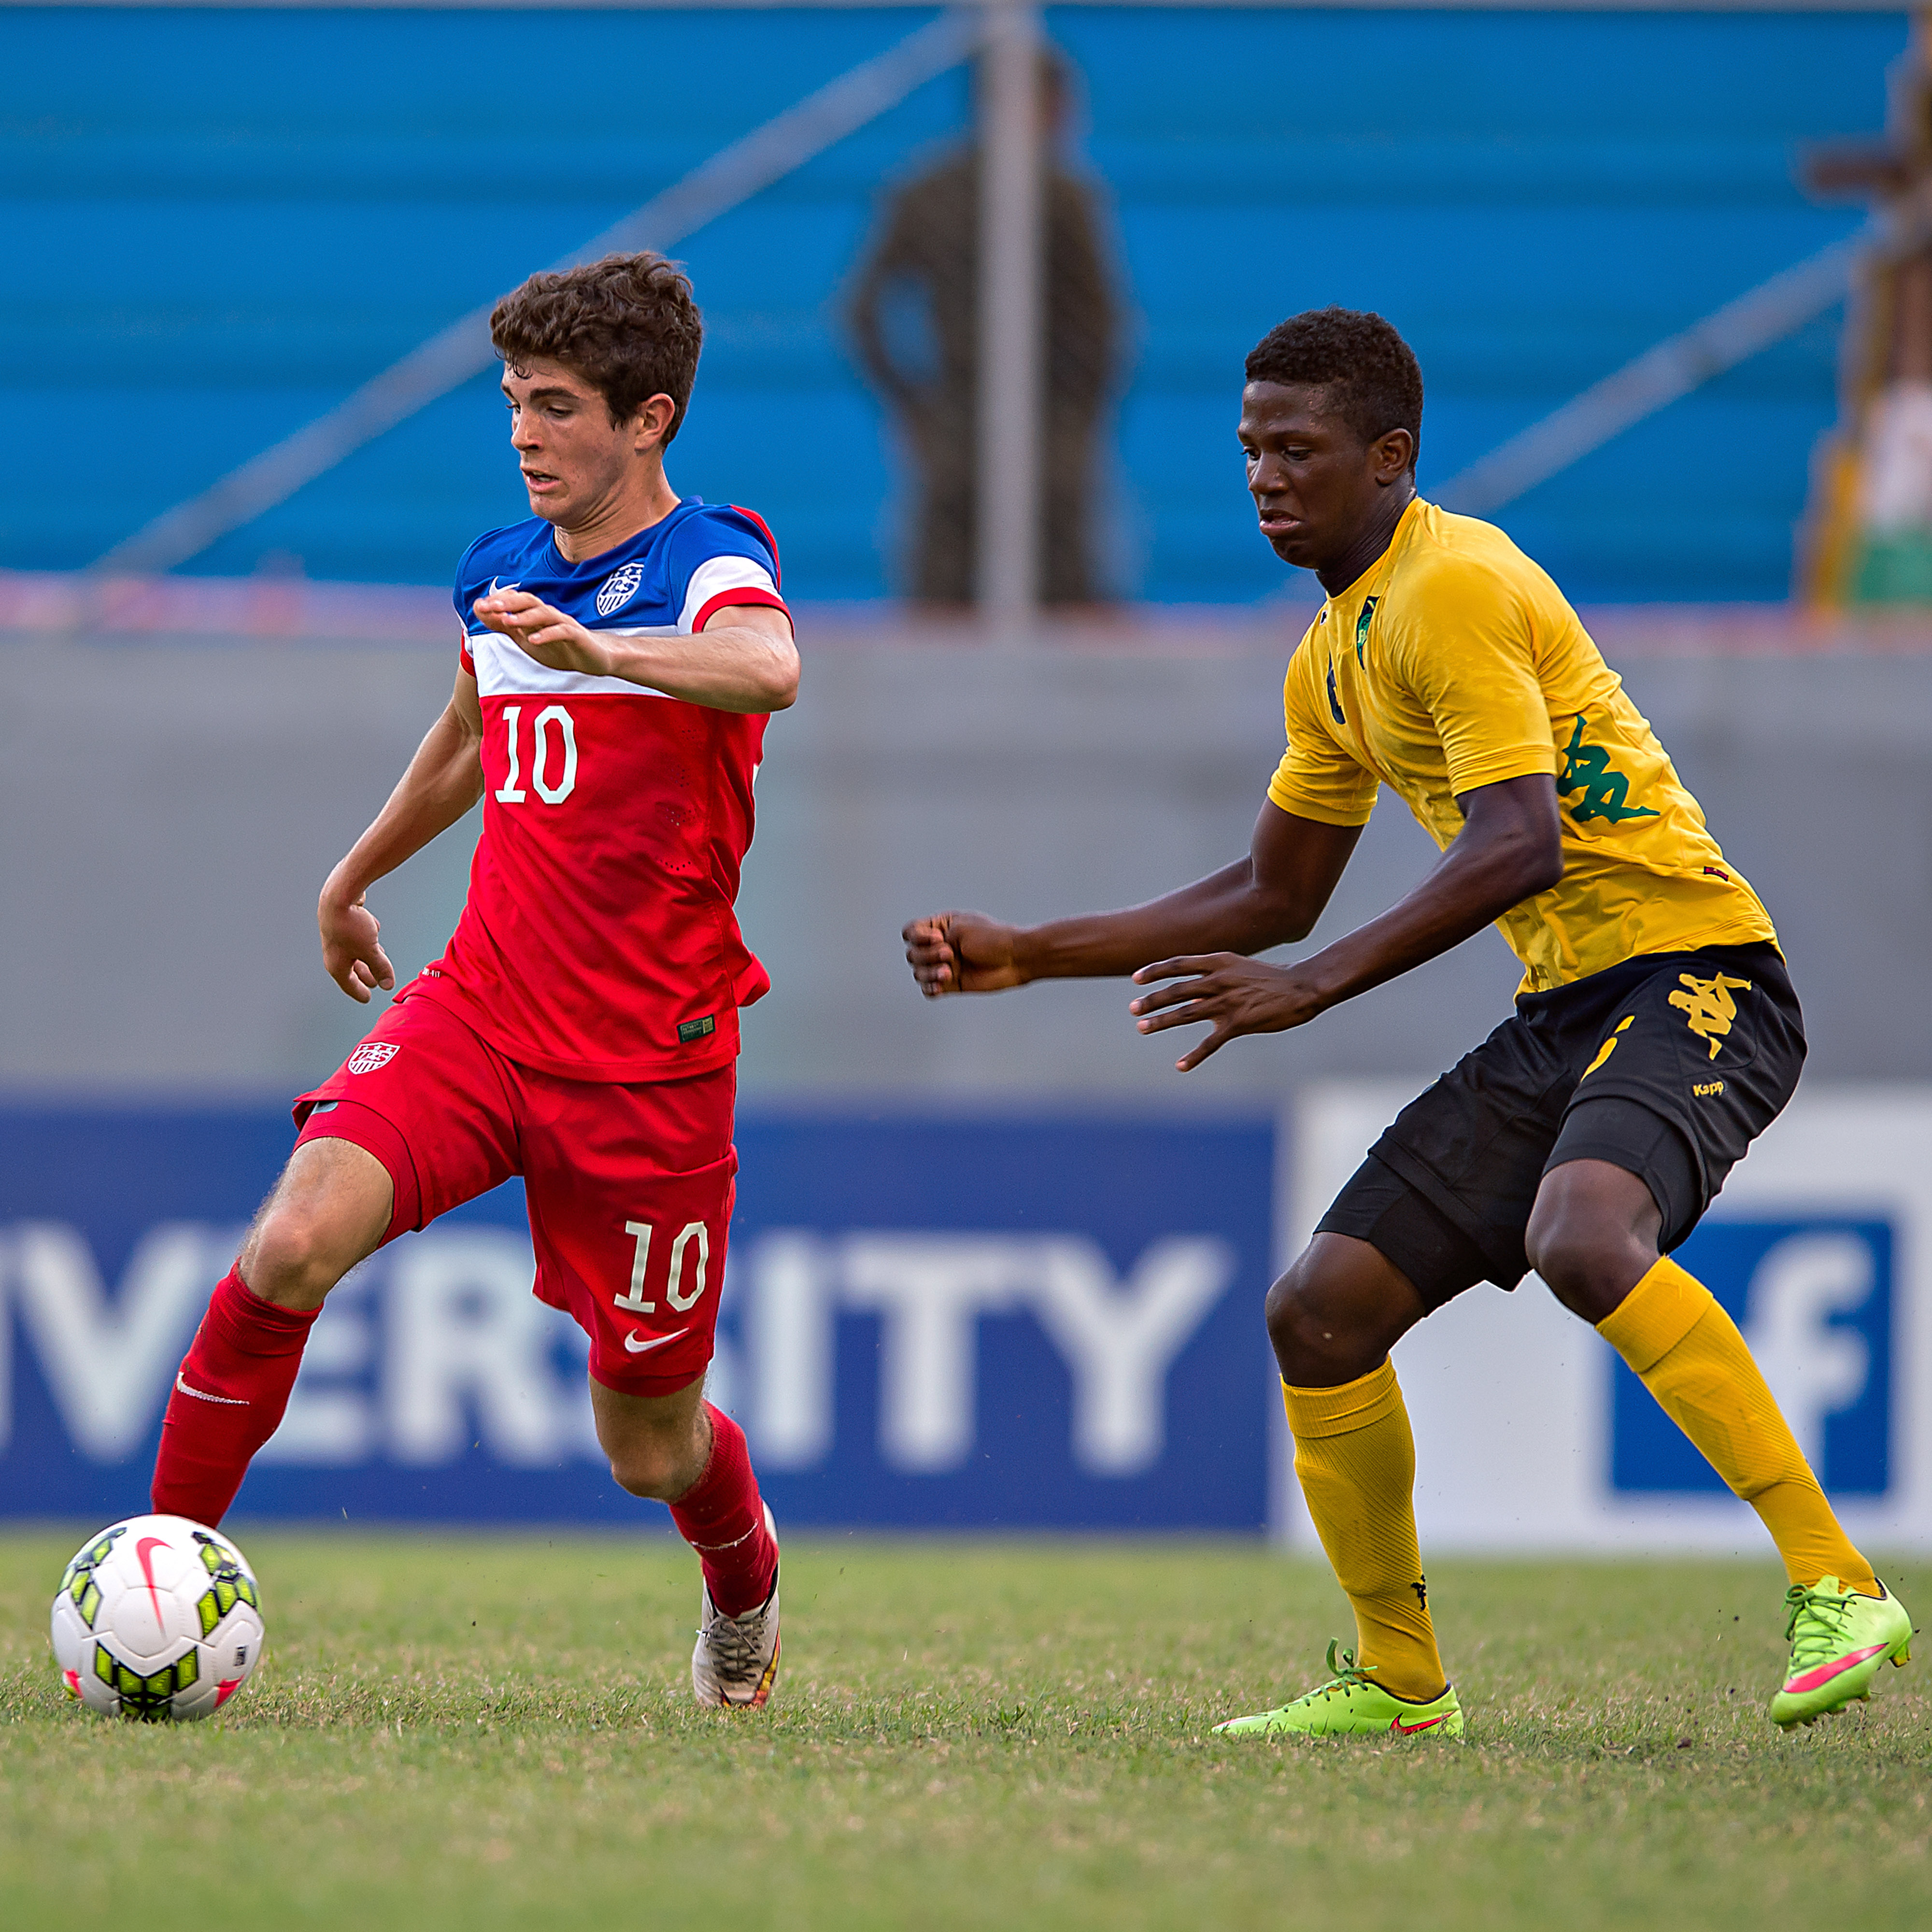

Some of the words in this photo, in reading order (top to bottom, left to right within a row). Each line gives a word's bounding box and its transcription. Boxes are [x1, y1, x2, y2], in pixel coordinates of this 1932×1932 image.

[495, 705, 577, 804] 10
[613, 1220, 709, 1313] 10
[0, 1223, 1229, 1471] VERITY
